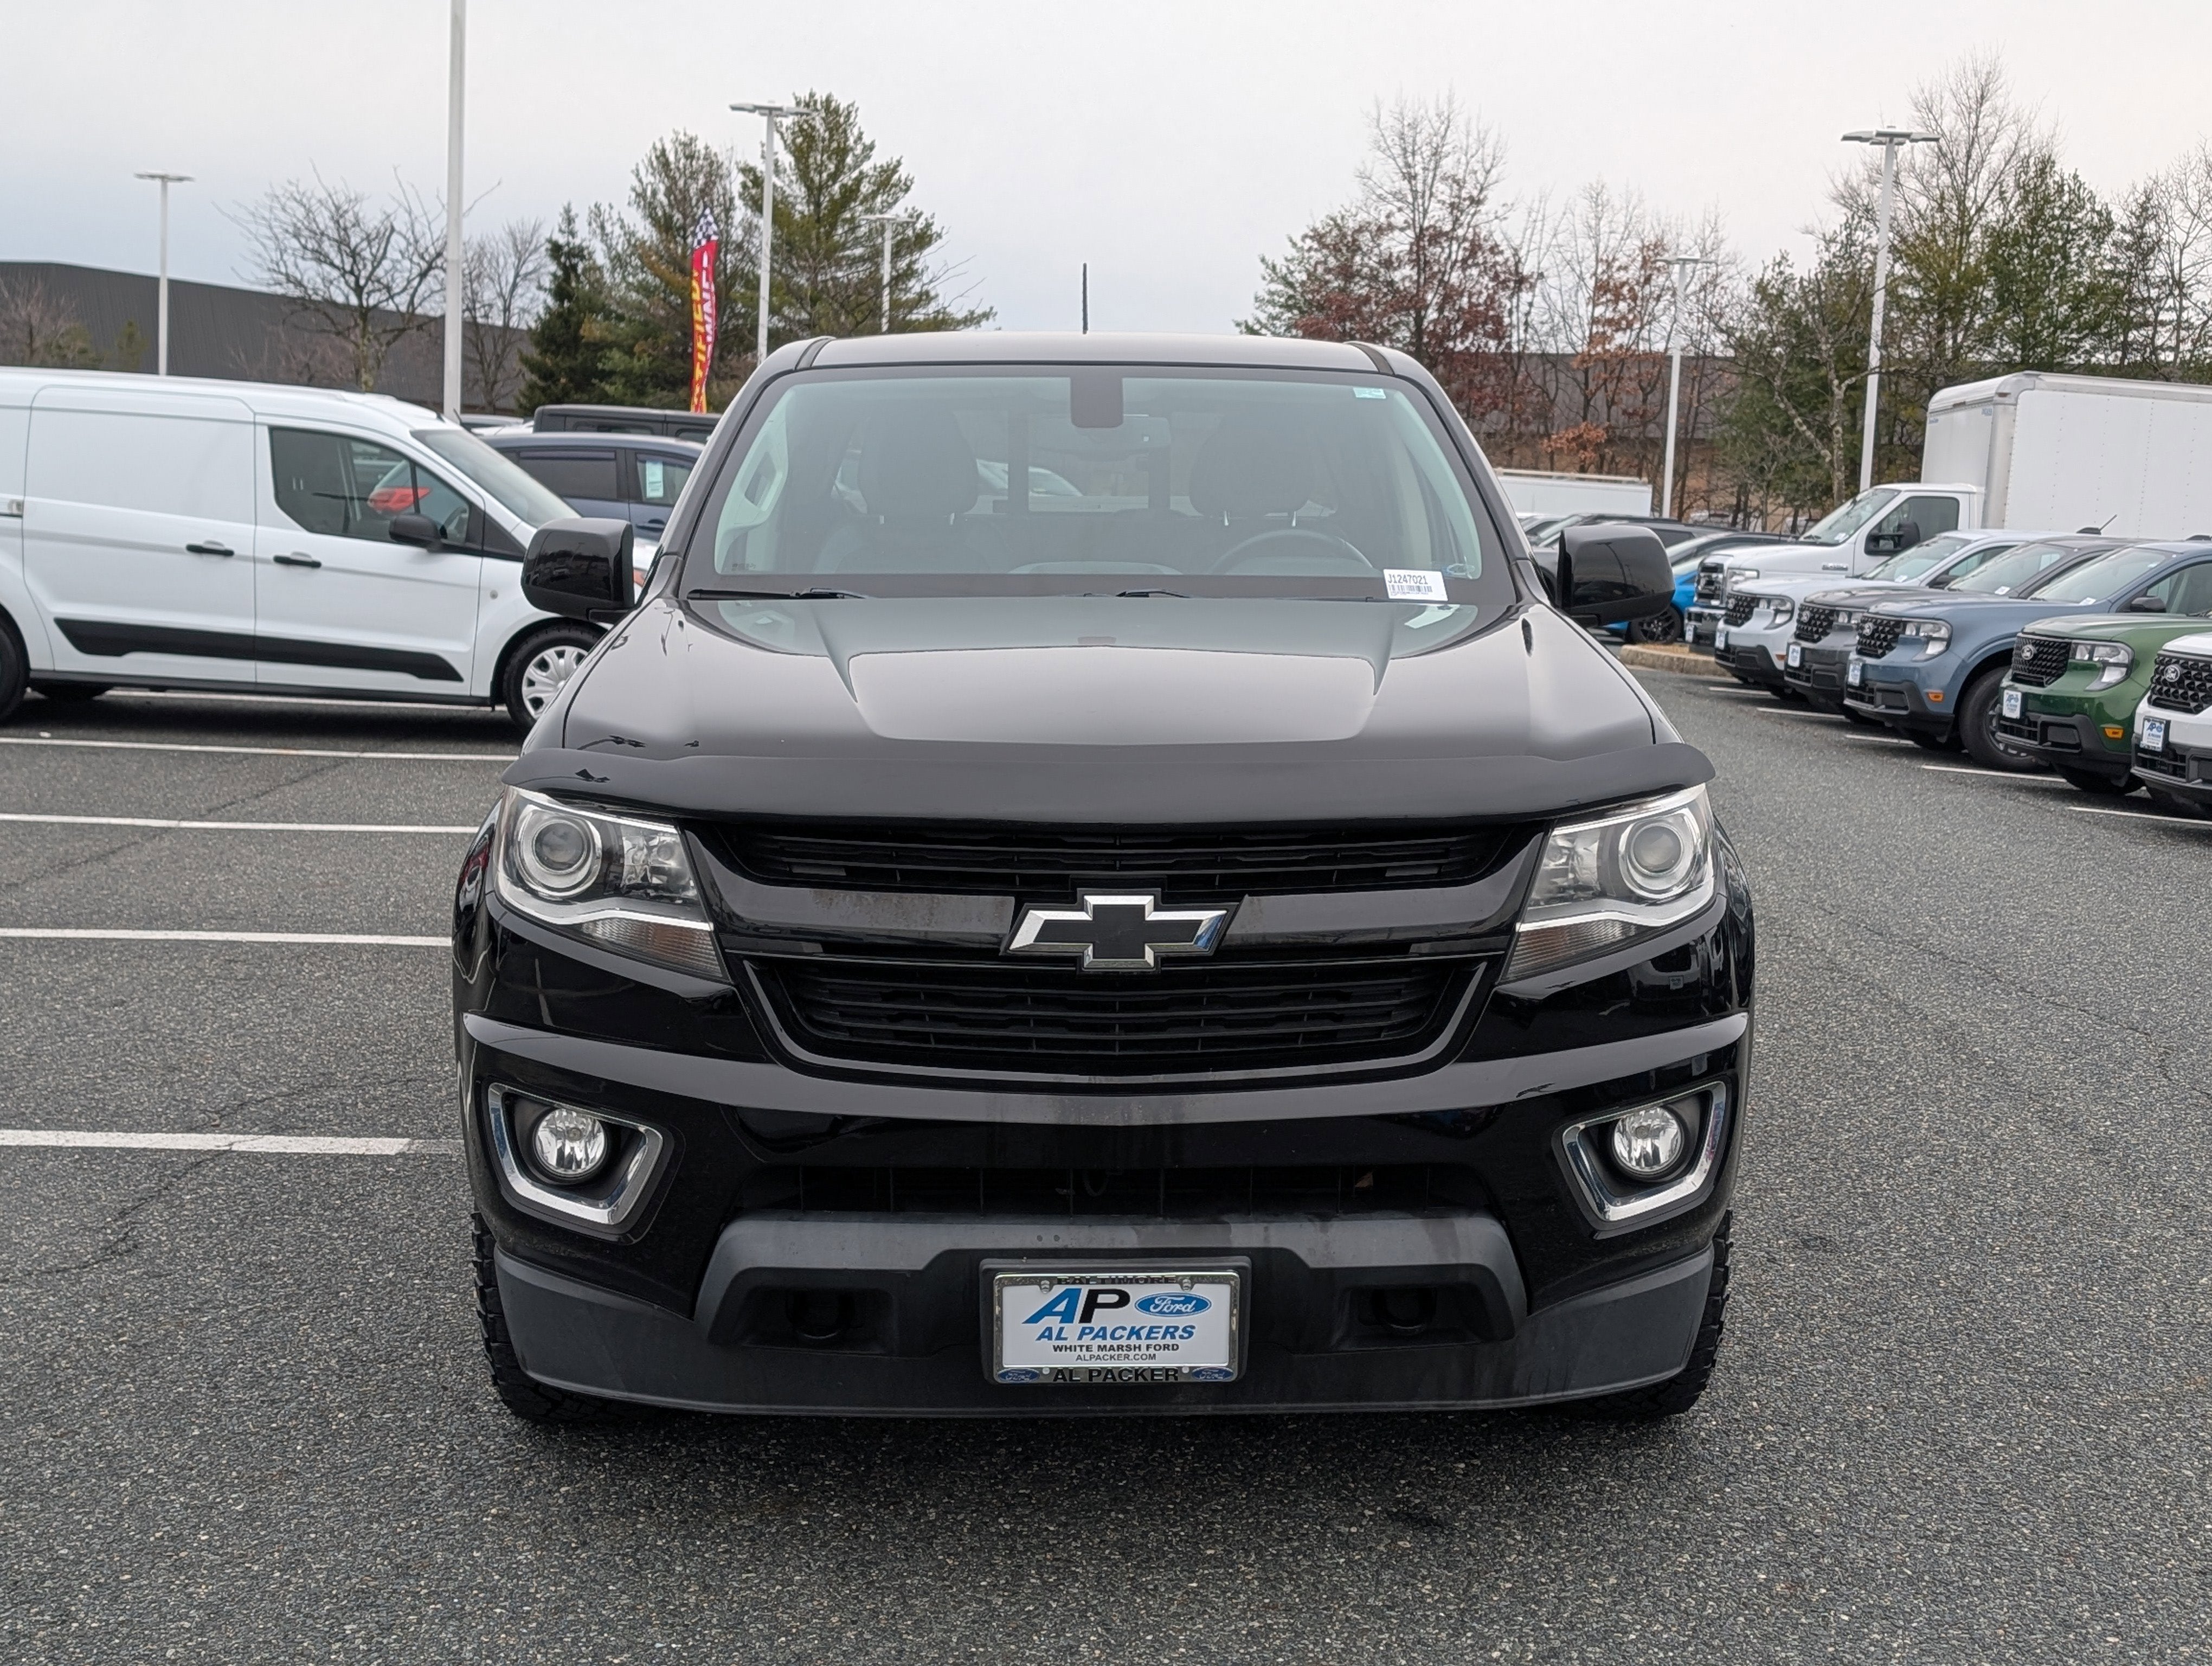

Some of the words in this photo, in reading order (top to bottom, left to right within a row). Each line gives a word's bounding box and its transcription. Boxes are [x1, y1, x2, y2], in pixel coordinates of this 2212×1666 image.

[1387, 574, 1428, 585] J1247021
[1057, 1275, 1176, 1284] BALTIMORE
[1021, 1287, 1130, 1324] AP
[1149, 1296, 1196, 1314] Ford
[1034, 1326, 1069, 1341] AL
[1077, 1324, 1196, 1341] PACKERS
[1052, 1344, 1093, 1353] WHITE
[1097, 1344, 1142, 1353] MARSH
[1146, 1343, 1179, 1351] FORD
[1075, 1353, 1156, 1361] ALPACKER.COM
[1053, 1367, 1081, 1382] AL
[1088, 1366, 1179, 1382] PACKER
